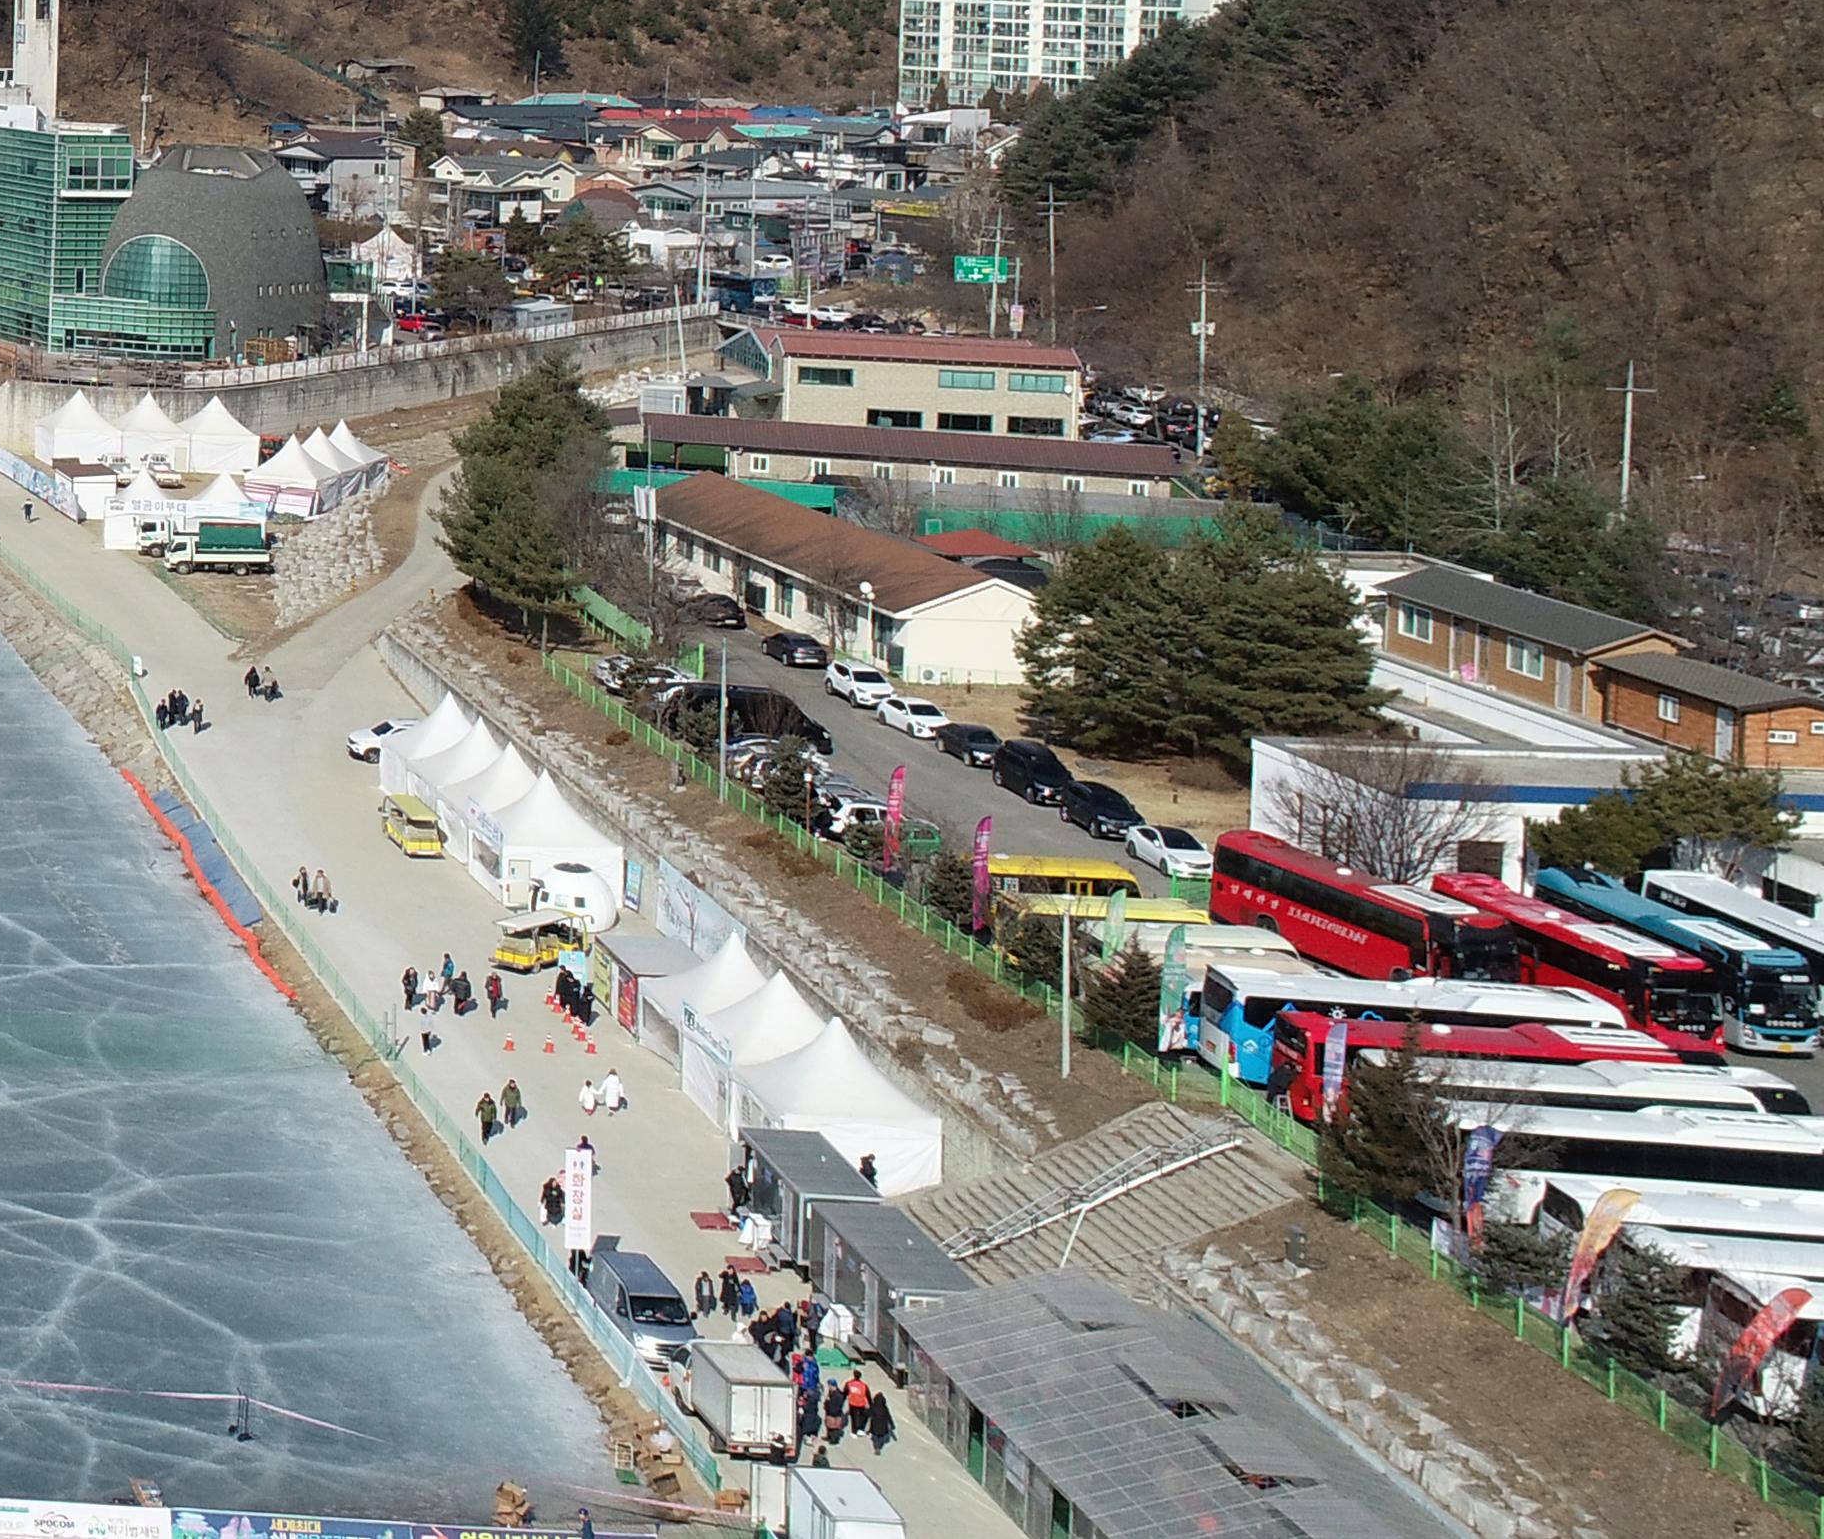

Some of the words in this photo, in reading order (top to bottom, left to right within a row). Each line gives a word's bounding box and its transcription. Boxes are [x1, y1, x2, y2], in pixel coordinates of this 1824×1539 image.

[572, 1172, 586, 1221] 화장실
[33, 1517, 75, 1528] SPOCOM
[269, 1518, 322, 1534] 세계최대
